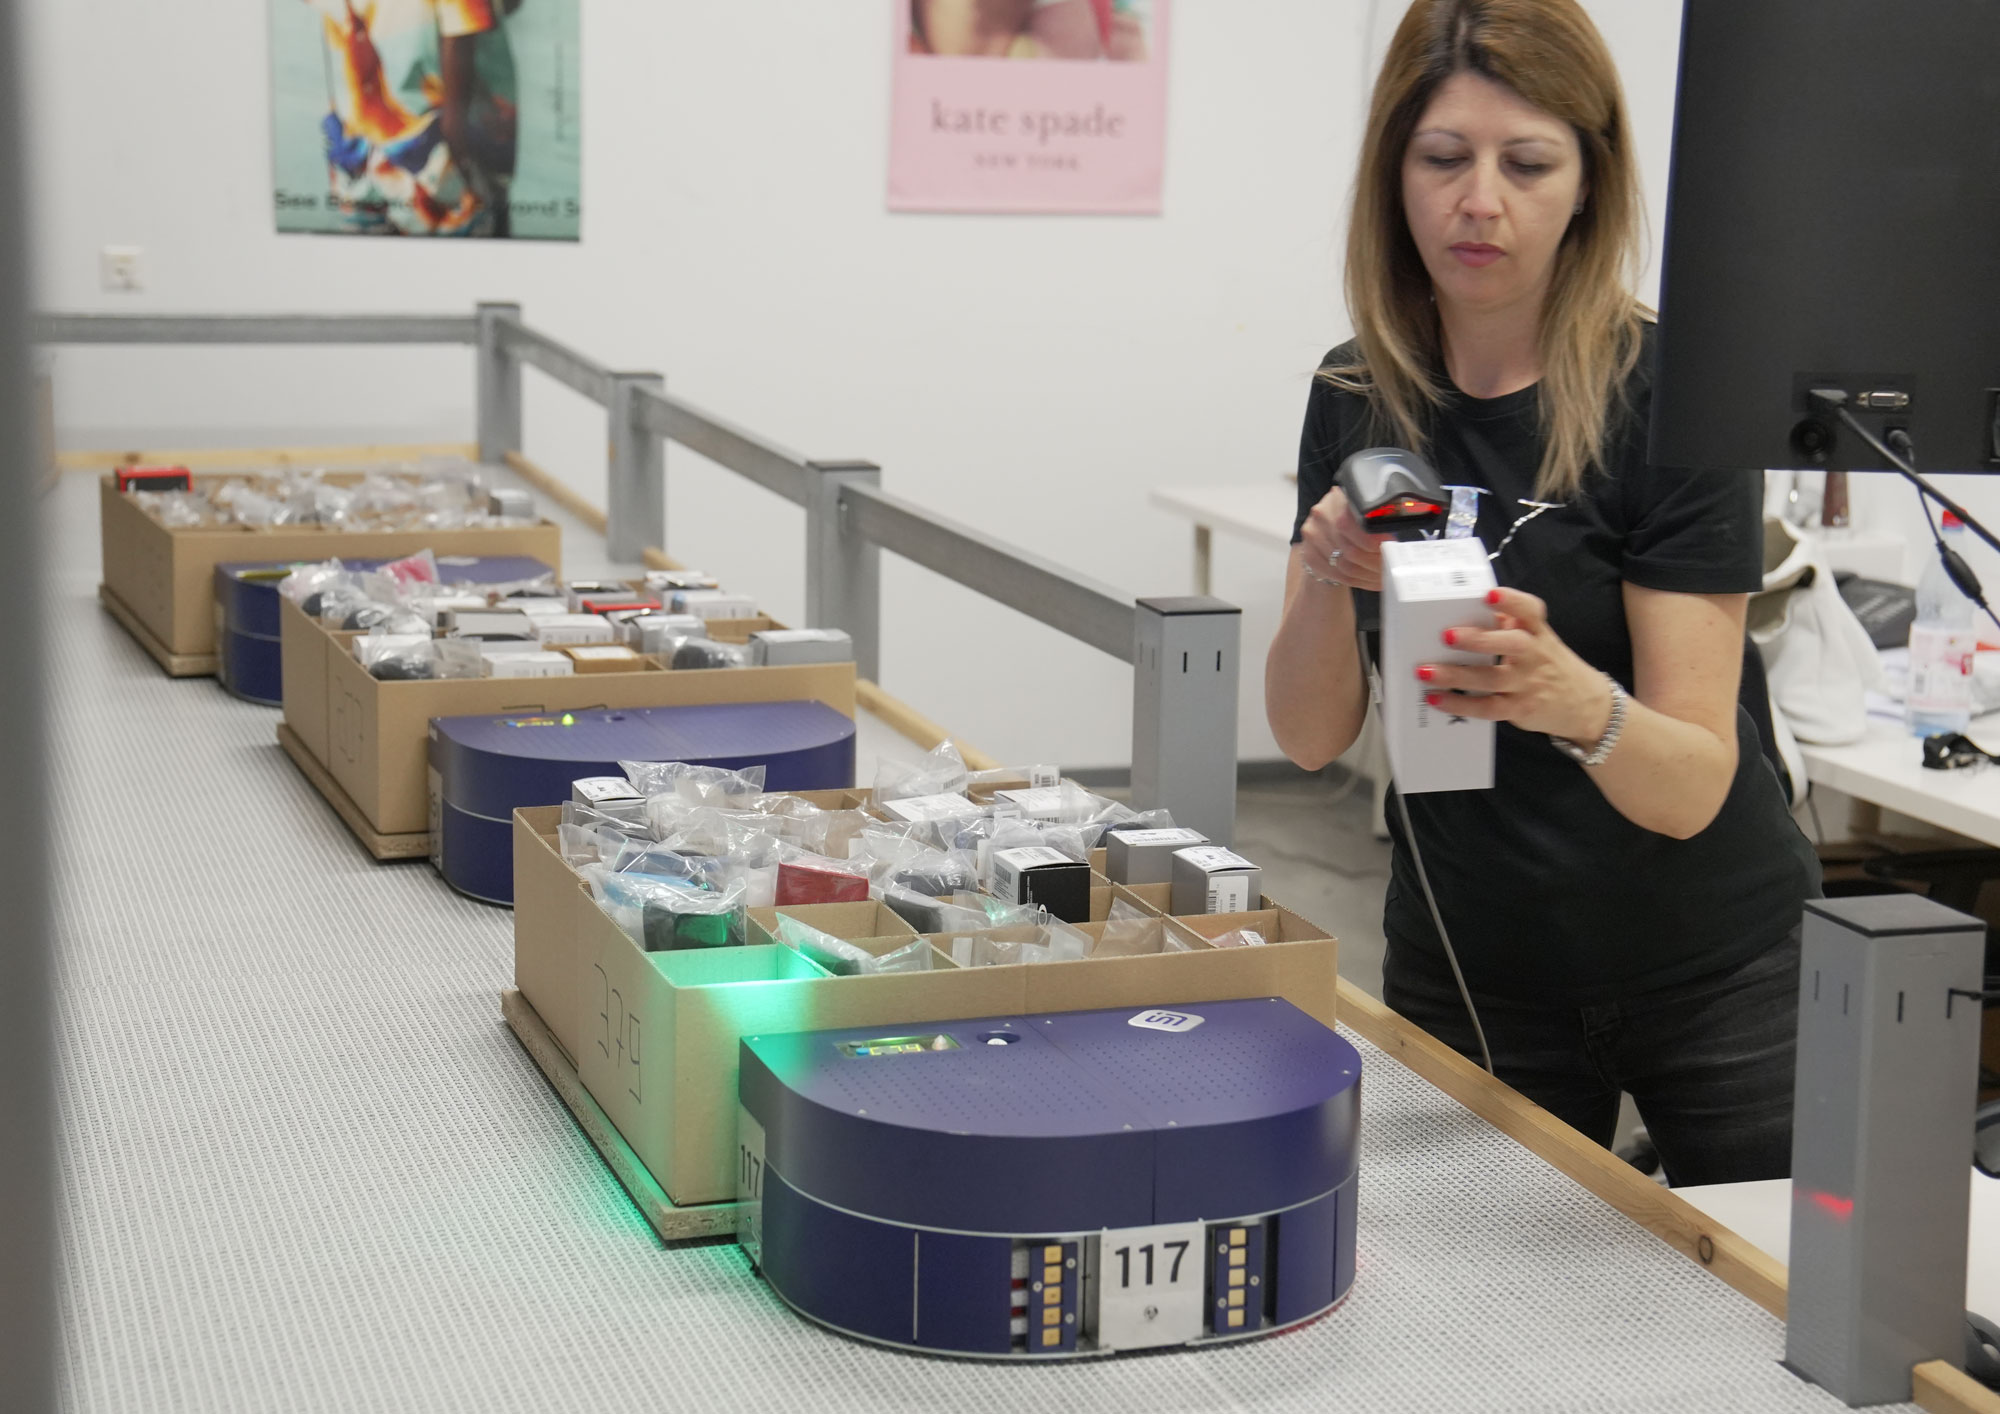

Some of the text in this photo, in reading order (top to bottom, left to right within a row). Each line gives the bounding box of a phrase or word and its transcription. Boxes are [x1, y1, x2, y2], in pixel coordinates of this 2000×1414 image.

[931, 97, 1126, 146] kate spade
[741, 1144, 760, 1199] 117
[1114, 1240, 1190, 1289] 117
